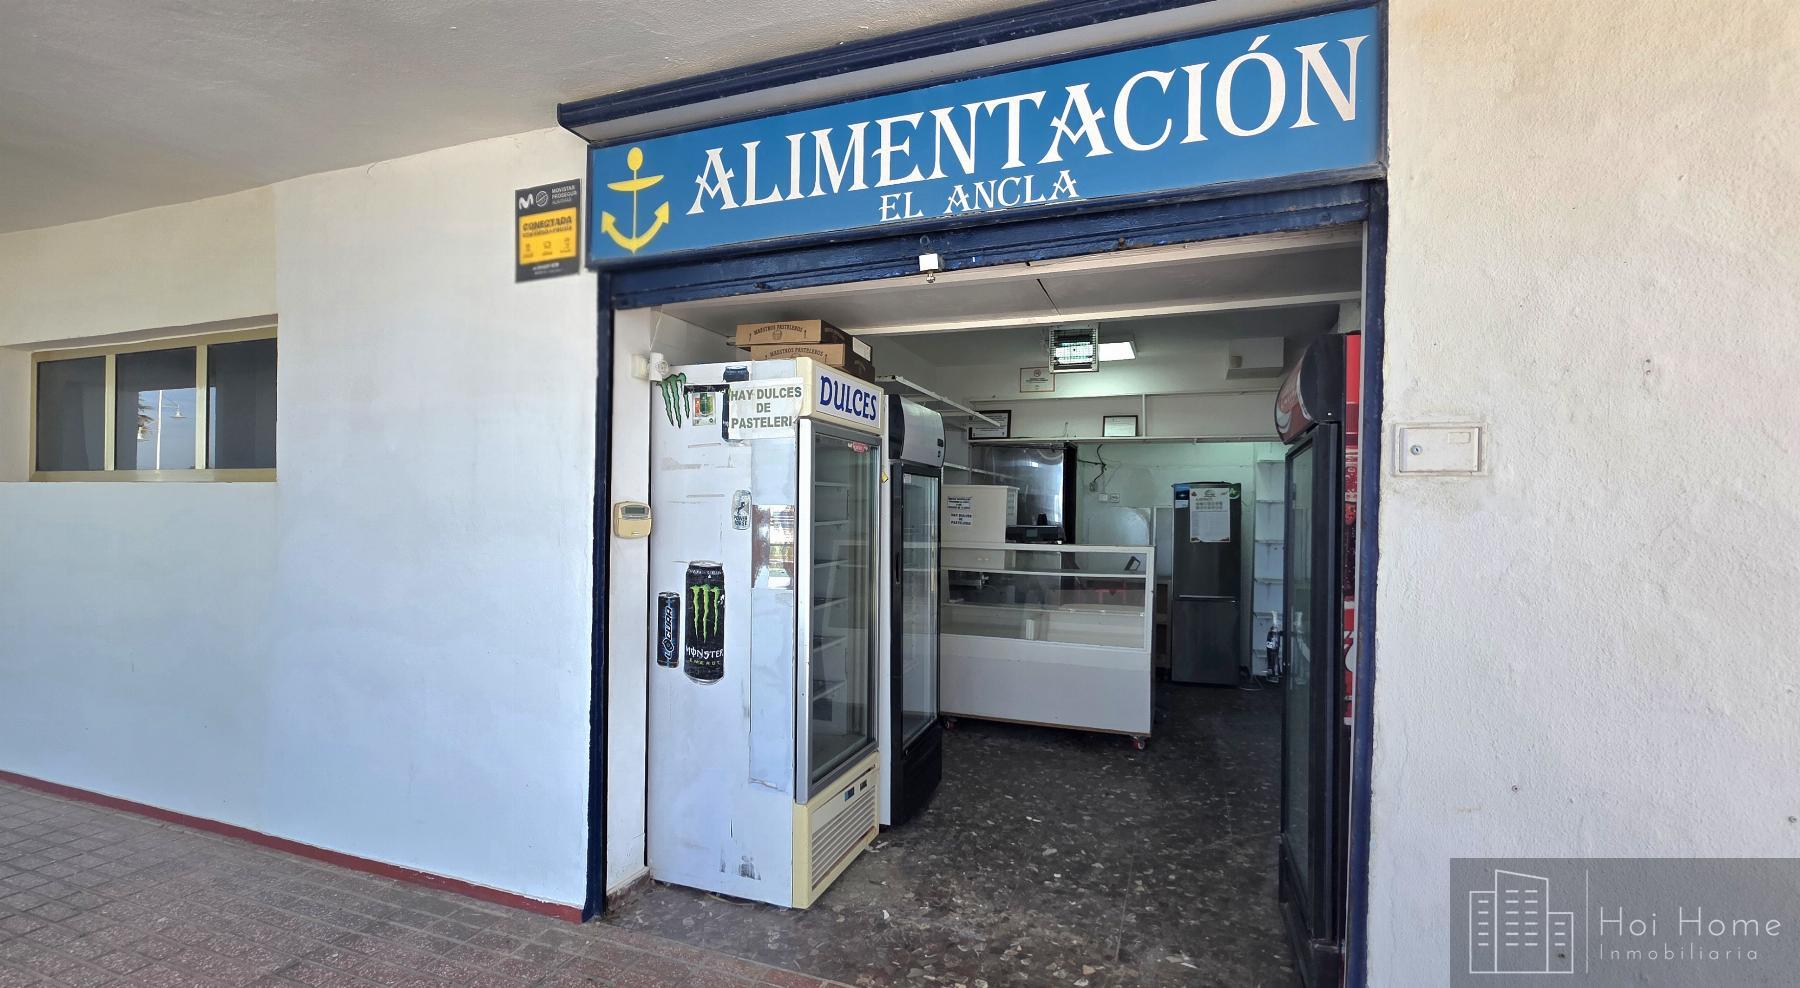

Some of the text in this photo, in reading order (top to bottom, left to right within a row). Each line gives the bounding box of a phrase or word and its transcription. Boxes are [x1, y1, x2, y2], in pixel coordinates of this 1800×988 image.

[686, 35, 1367, 215] ALIMENTACIÓN
[879, 169, 1080, 223] EL ANCLA
[522, 215, 572, 231] CONECTADA
[753, 323, 803, 335] MAESTROS PASTELEROS
[769, 347, 824, 357] MAESTROS PASTELEROS
[731, 389, 754, 401] HAY
[756, 386, 802, 400] DULCES
[819, 375, 877, 421] DULCES
[756, 402, 771, 413] DE
[685, 644, 724, 660] MONSTER
